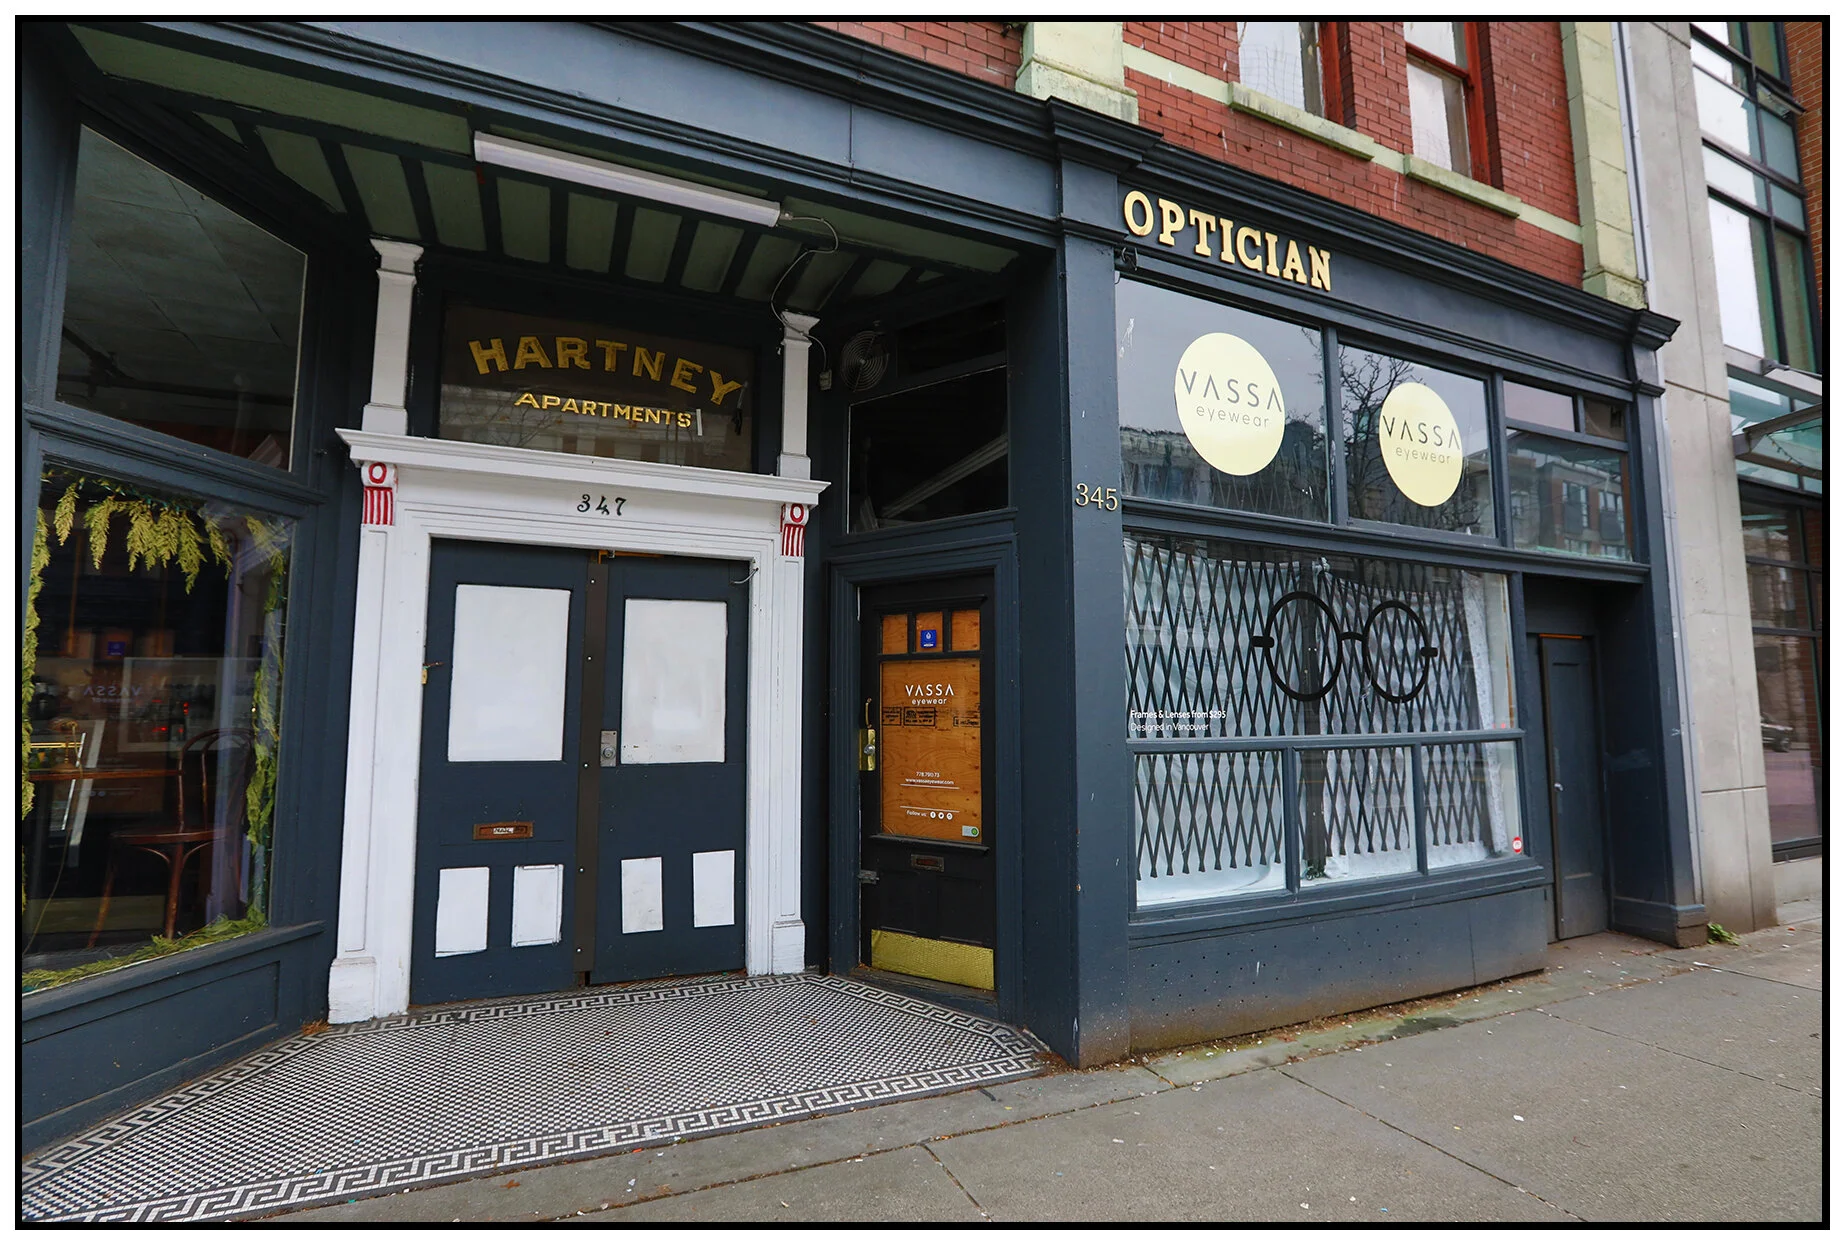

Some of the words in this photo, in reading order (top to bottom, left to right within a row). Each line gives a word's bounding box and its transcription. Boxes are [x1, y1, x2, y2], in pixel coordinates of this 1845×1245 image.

[1123, 190, 1332, 292] OPTICIAN
[468, 336, 742, 405] HARTNEY
[1180, 368, 1282, 412] VASSA
[514, 392, 692, 428] APARTMENTS
[1196, 406, 1269, 428] eyewear
[1382, 415, 1460, 450] VASSA
[1395, 446, 1451, 464] eyewear
[576, 494, 627, 516] 347
[1075, 483, 1118, 512] 345
[905, 683, 954, 697] VASSA
[911, 698, 947, 706] eyewear
[1130, 710, 1157, 719] Frames
[1158, 710, 1164, 719] &
[1165, 711, 1190, 719] Lenses
[1191, 710, 1208, 719] from
[1209, 710, 1226, 720] $295
[1130, 722, 1164, 734] Designed
[1165, 723, 1172, 731] in
[1172, 723, 1209, 732] Vancouver
